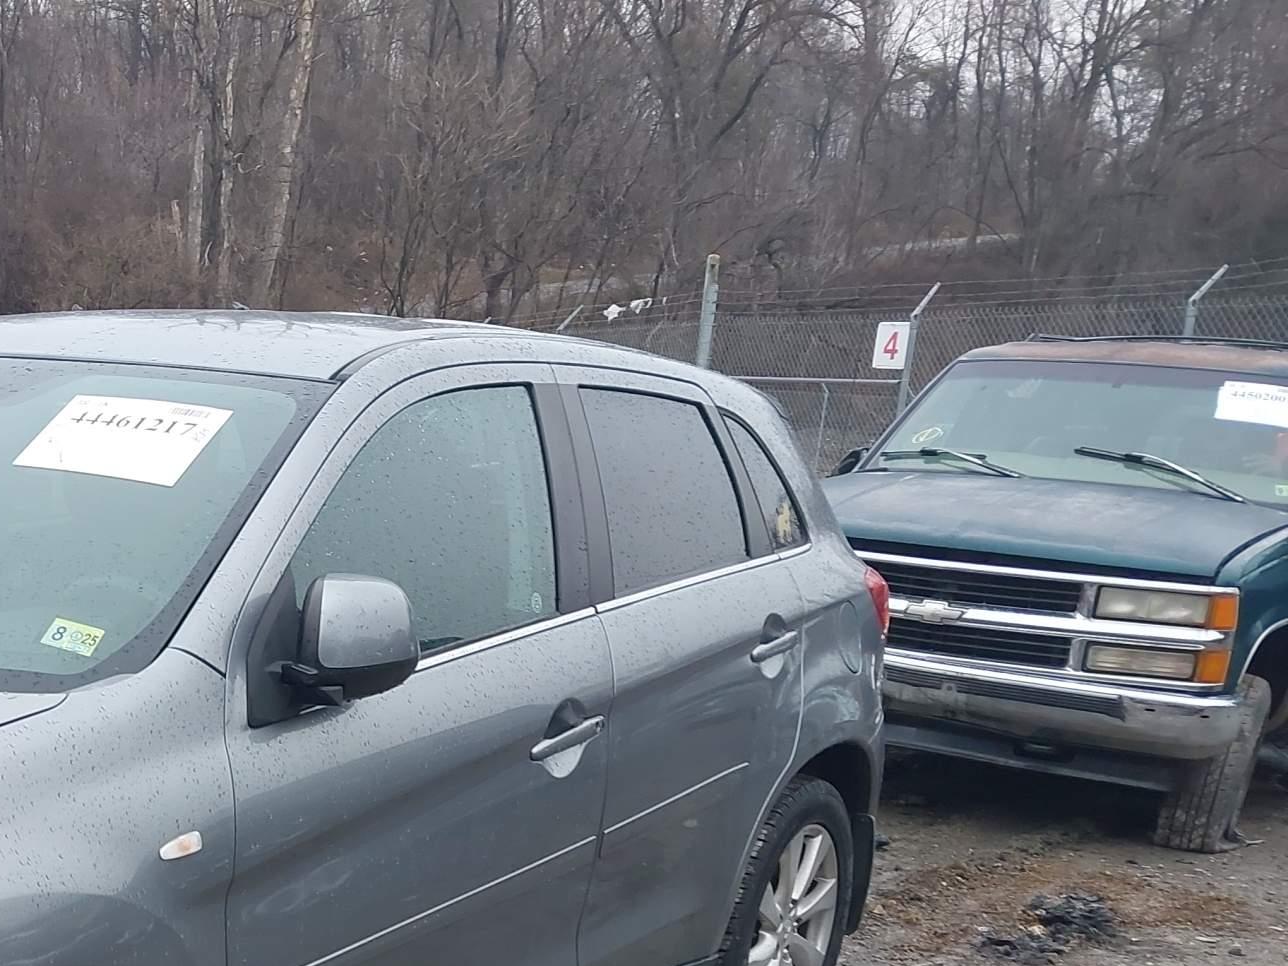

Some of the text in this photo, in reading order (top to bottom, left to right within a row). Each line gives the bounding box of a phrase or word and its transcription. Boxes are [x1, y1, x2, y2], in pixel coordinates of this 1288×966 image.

[883, 331, 899, 361] 4
[70, 410, 198, 436] 44461217
[52, 626, 67, 641] 8
[81, 633, 100, 647] 25
